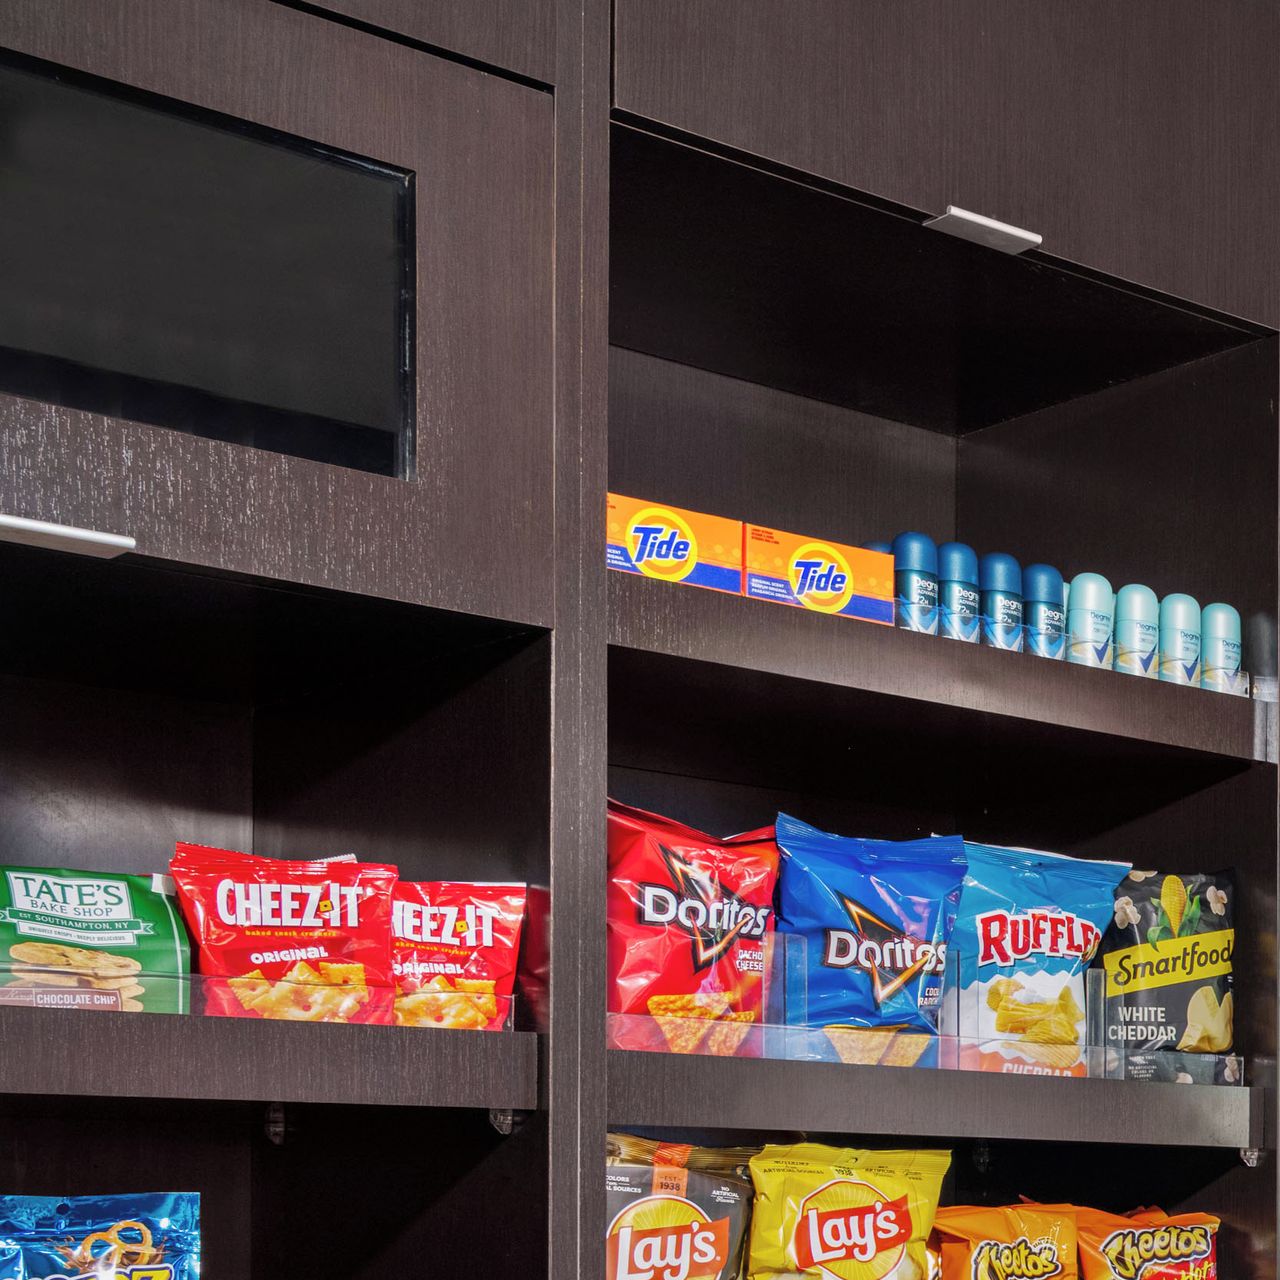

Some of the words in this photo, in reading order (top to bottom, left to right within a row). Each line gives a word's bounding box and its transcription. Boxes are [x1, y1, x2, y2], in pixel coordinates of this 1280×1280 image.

[632, 526, 690, 563] Tide
[794, 560, 847, 597] Tide
[15, 876, 124, 906] TATE'S
[31, 899, 67, 914] BAKE
[74, 907, 113, 917] SHOP
[216, 878, 363, 927] CHEEZ-IT
[642, 886, 771, 938] Doritos
[250, 946, 328, 964] ORIGINAL
[828, 930, 948, 973] Doritos
[1113, 940, 1233, 985] Smartfood
[36, 994, 91, 1005] CHOCOLATE
[94, 995, 116, 1005] CHIP
[1118, 1007, 1166, 1022] WHITE
[1108, 1026, 1177, 1041] CHEDDAR
[659, 1181, 681, 1192] 1938
[808, 1202, 900, 1263] Lay's
[1104, 1228, 1210, 1280] Cheetos
